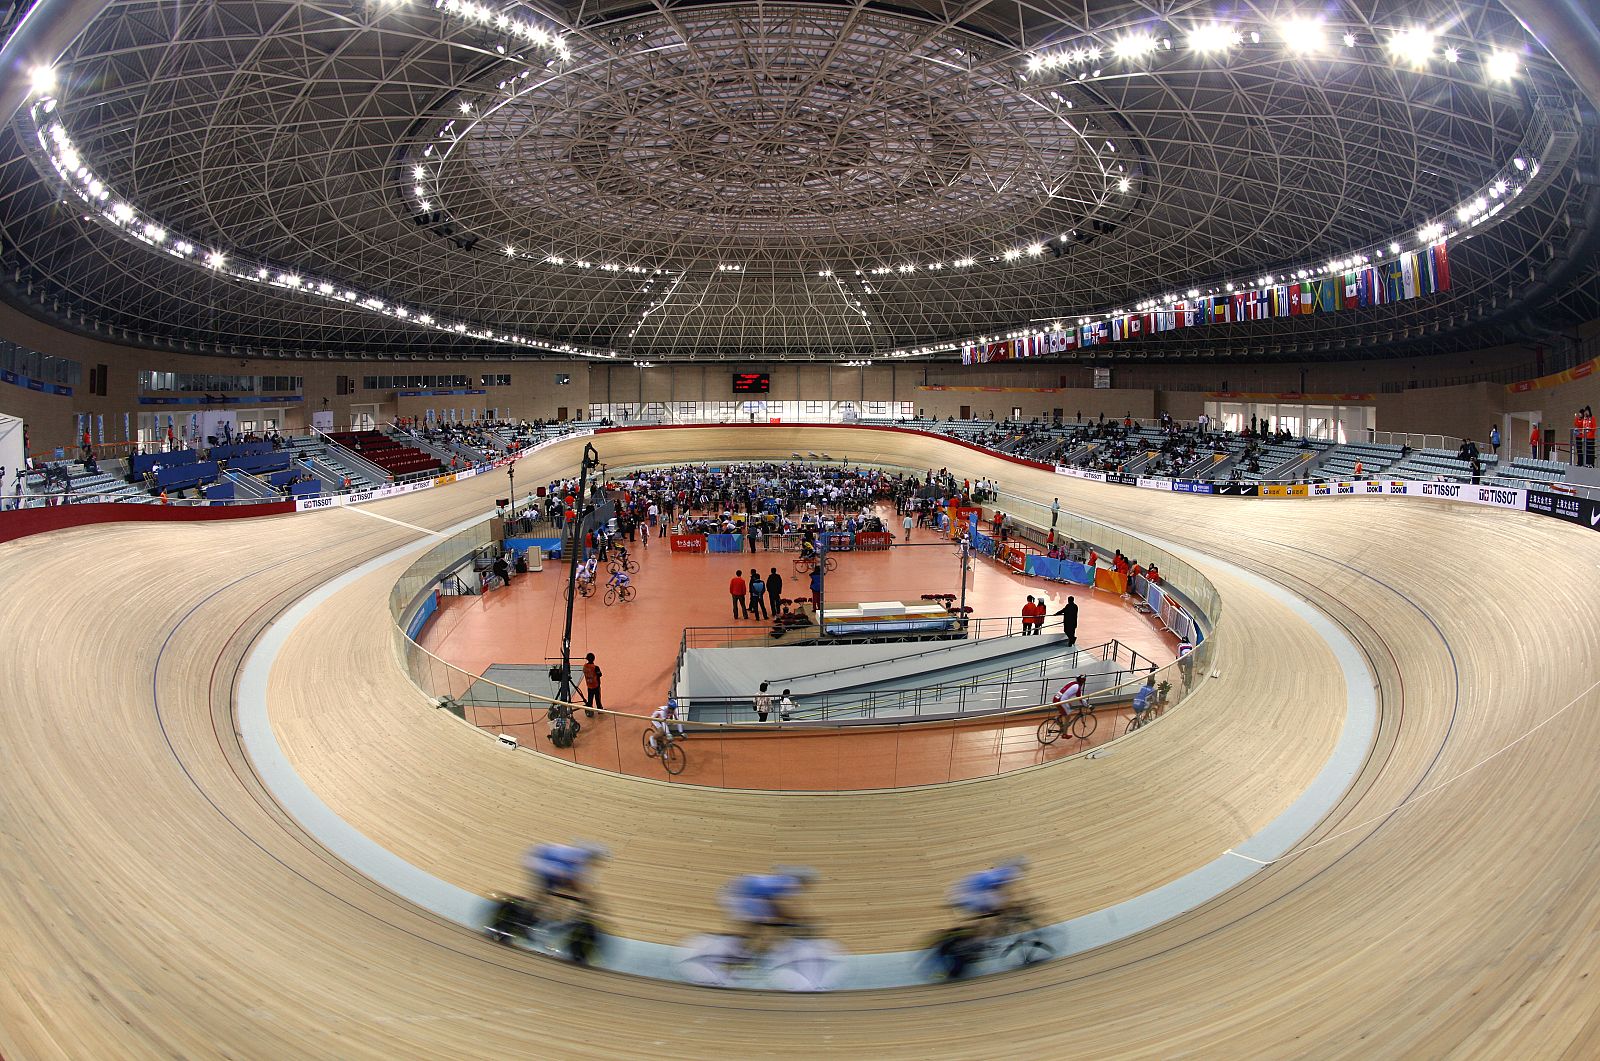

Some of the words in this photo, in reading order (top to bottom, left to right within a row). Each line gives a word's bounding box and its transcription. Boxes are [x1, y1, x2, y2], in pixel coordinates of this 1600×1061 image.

[1390, 486, 1403, 494] LOOK
[1433, 484, 1461, 497] TISSOT
[357, 492, 374, 501] TISSOT
[1490, 489, 1518, 505] TISSOT
[312, 498, 332, 508] TISSOT
